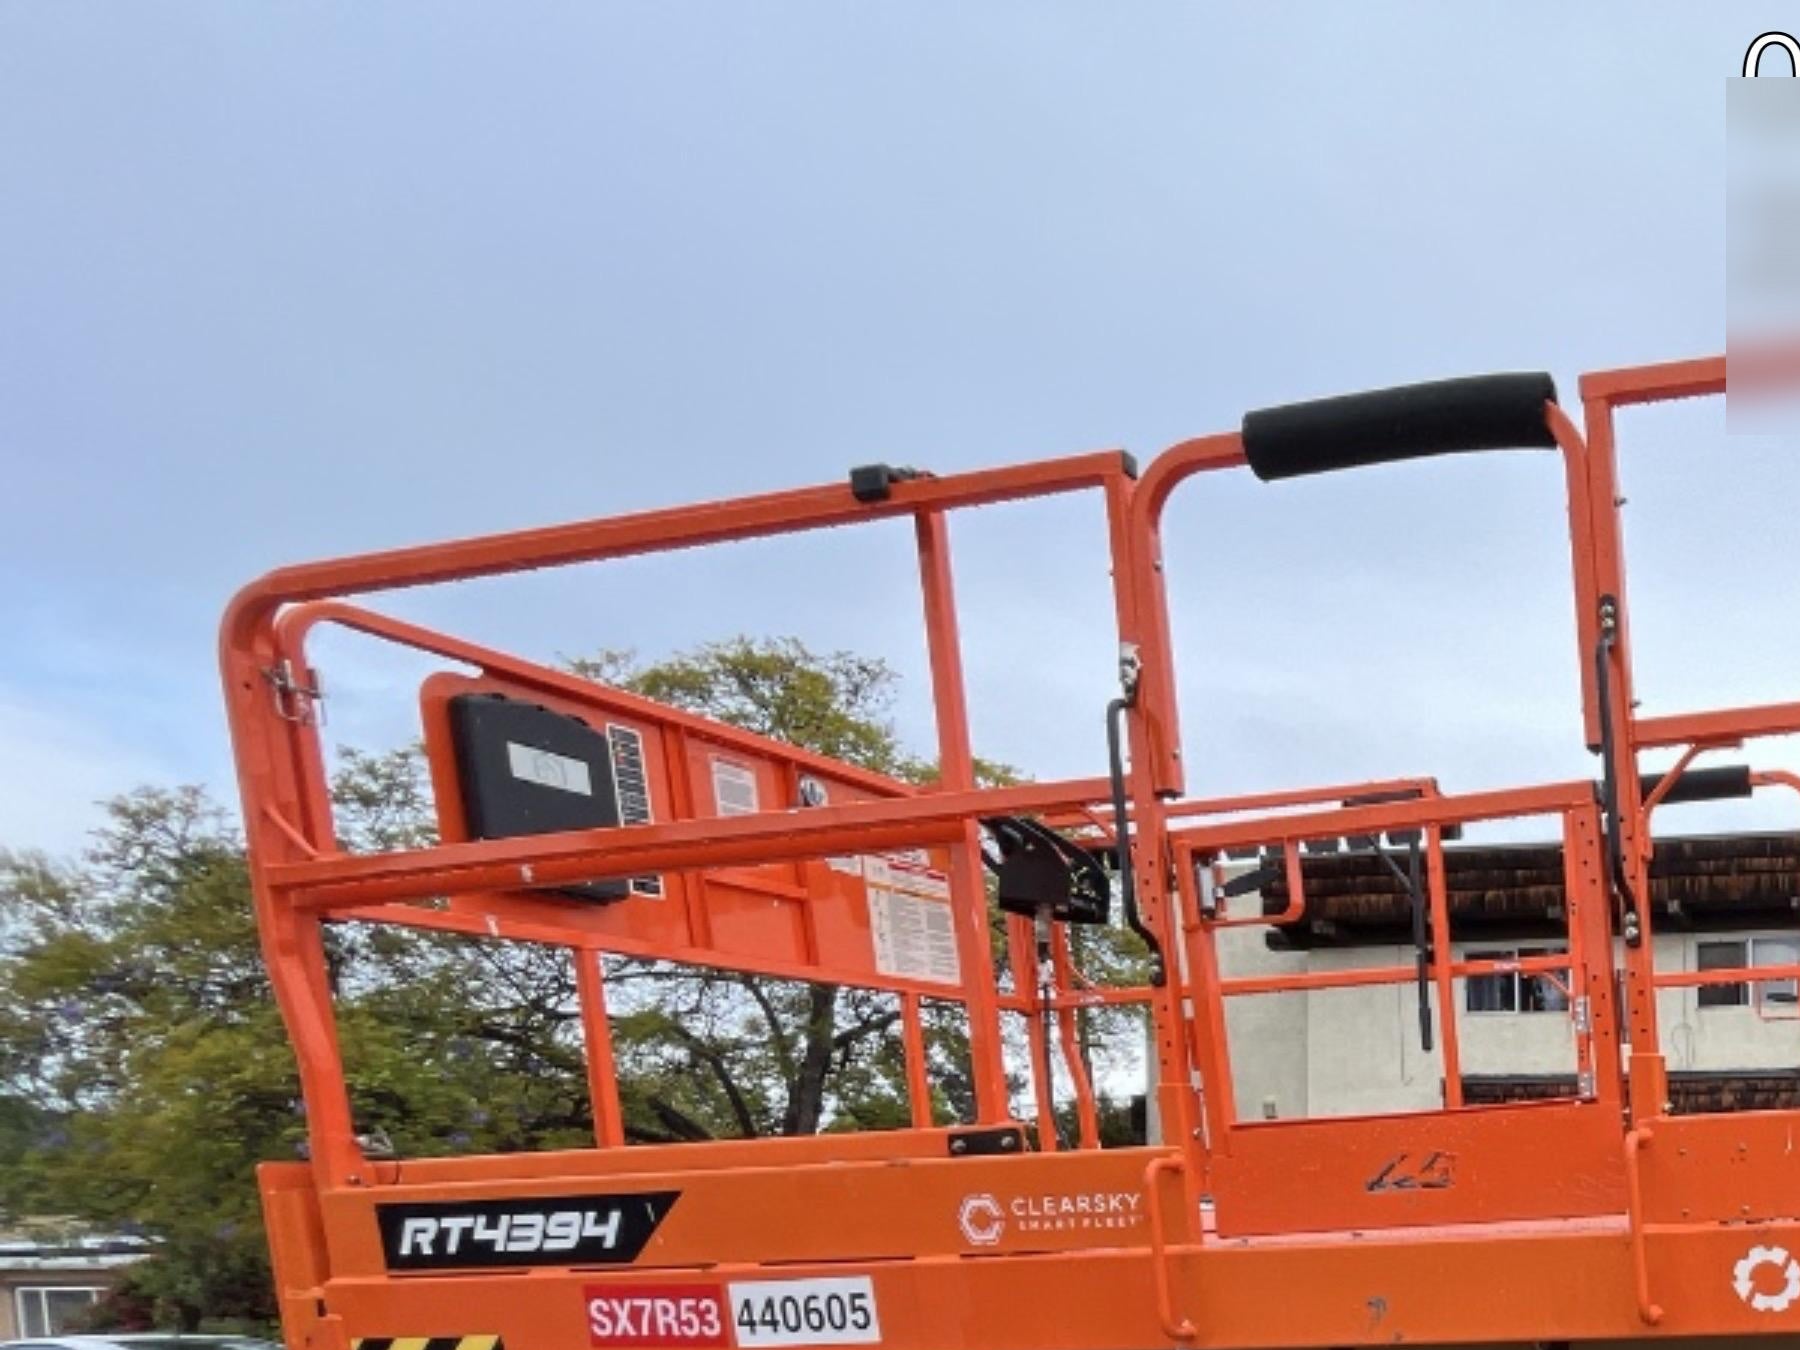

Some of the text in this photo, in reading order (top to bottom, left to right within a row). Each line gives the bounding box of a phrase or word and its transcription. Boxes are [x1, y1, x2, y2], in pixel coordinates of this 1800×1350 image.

[1010, 1193, 1142, 1216] CLEARSKY
[399, 1210, 623, 1256] RT4394
[589, 1297, 721, 1337] SX7R53
[737, 1292, 871, 1336] 440605
